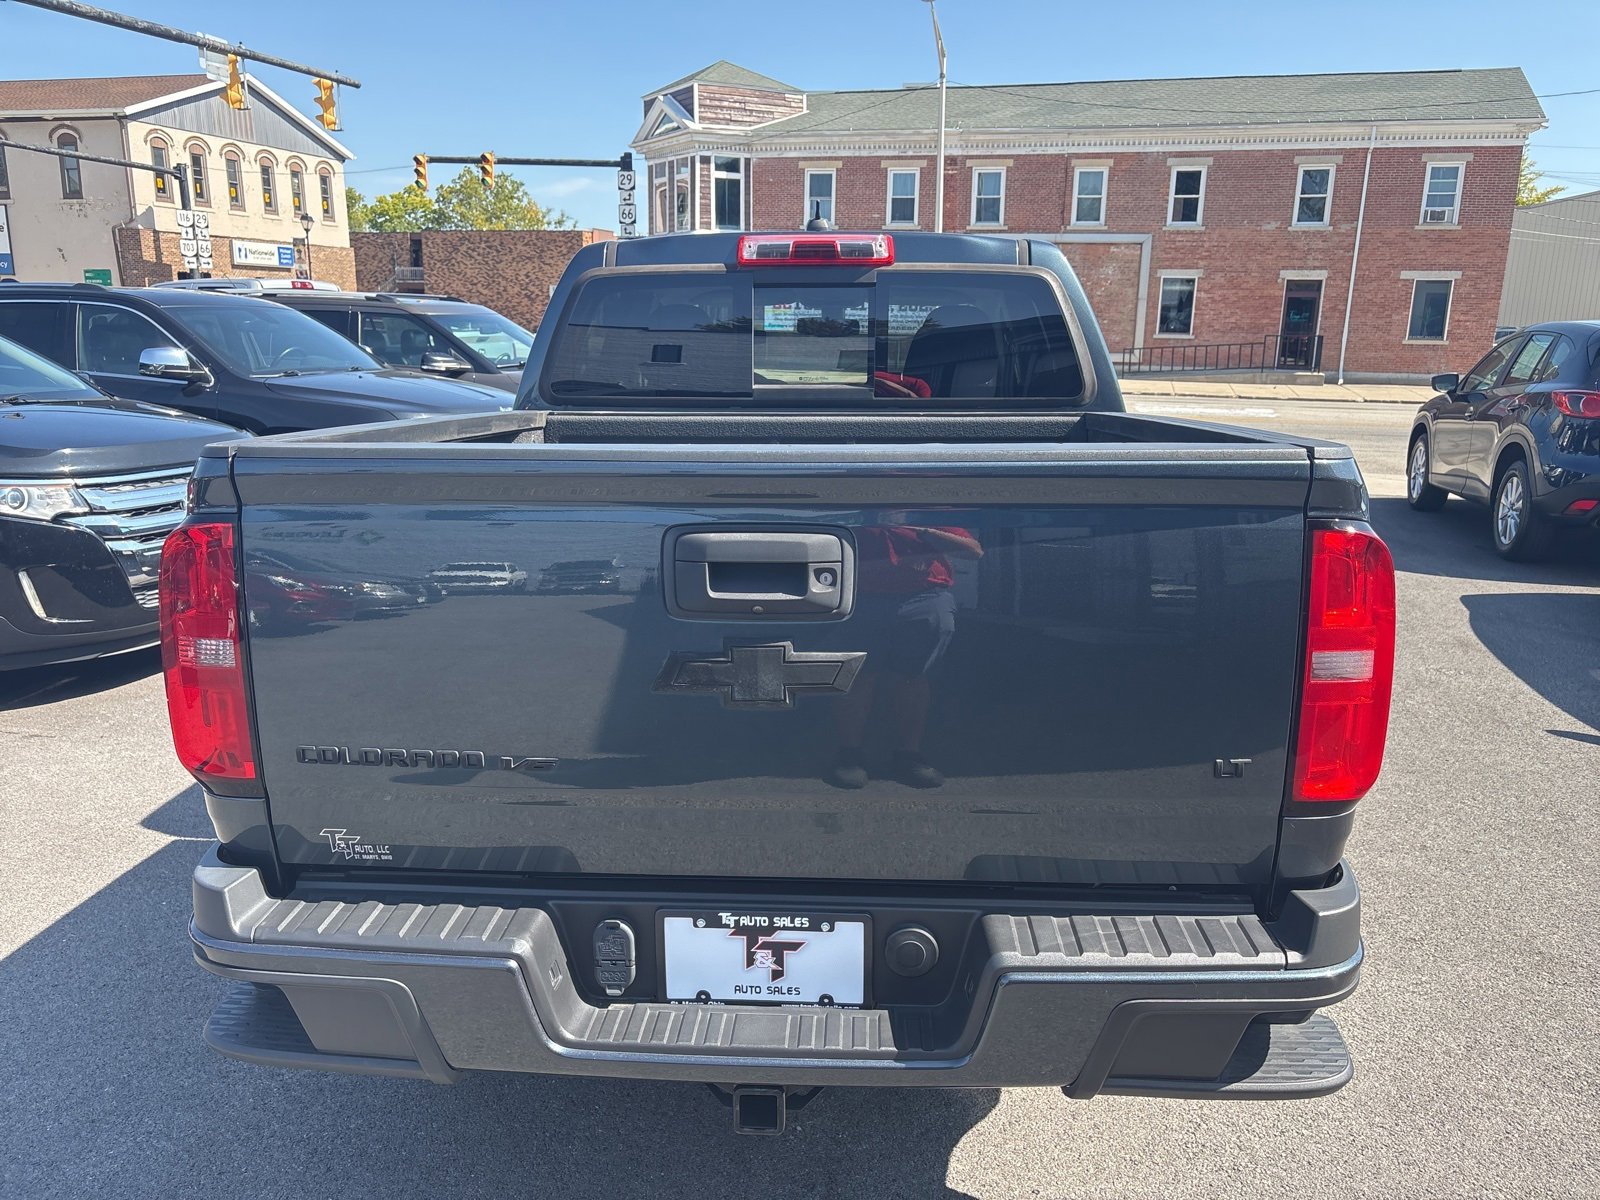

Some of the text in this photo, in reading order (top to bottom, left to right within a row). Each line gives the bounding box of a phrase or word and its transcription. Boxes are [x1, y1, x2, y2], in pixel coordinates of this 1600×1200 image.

[620, 174, 632, 185] 29
[179, 213, 190, 222] 116
[196, 214, 207, 224] 29
[621, 208, 633, 219] 66
[182, 243, 194, 252] 703
[200, 244, 210, 253] 66
[296, 745, 558, 770] COLORADO V6
[1214, 758, 1252, 778] LT
[377, 845, 390, 854] LLC
[739, 915, 769, 927] AUTO
[773, 916, 810, 928] SALES
[726, 929, 808, 983] T&T
[734, 984, 801, 996] AUTO SALES
